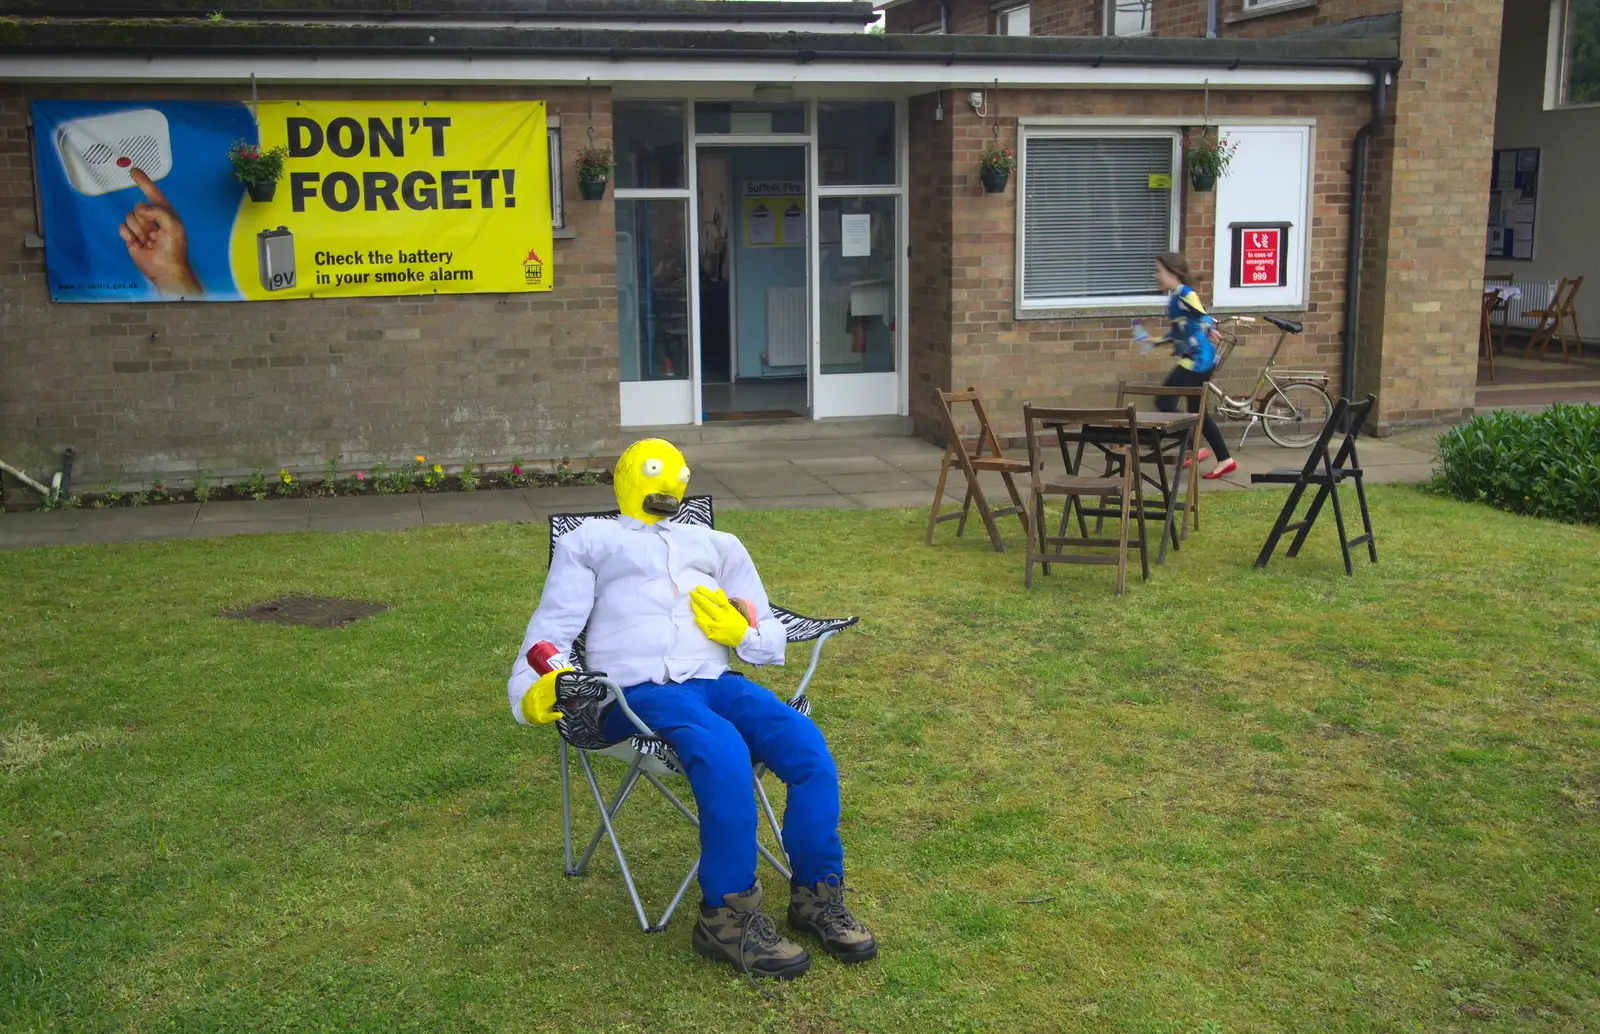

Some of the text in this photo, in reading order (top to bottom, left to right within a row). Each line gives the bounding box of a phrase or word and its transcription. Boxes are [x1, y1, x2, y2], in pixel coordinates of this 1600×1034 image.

[287, 116, 451, 158] DON'T
[290, 169, 516, 212] FORGET!
[747, 183, 802, 193] Suffolk Fire
[315, 249, 453, 266] Check the battery
[316, 267, 474, 287] in your smoke alarm
[525, 265, 541, 273] FIRE
[1252, 272, 1267, 280] 999
[273, 270, 295, 288] 9V
